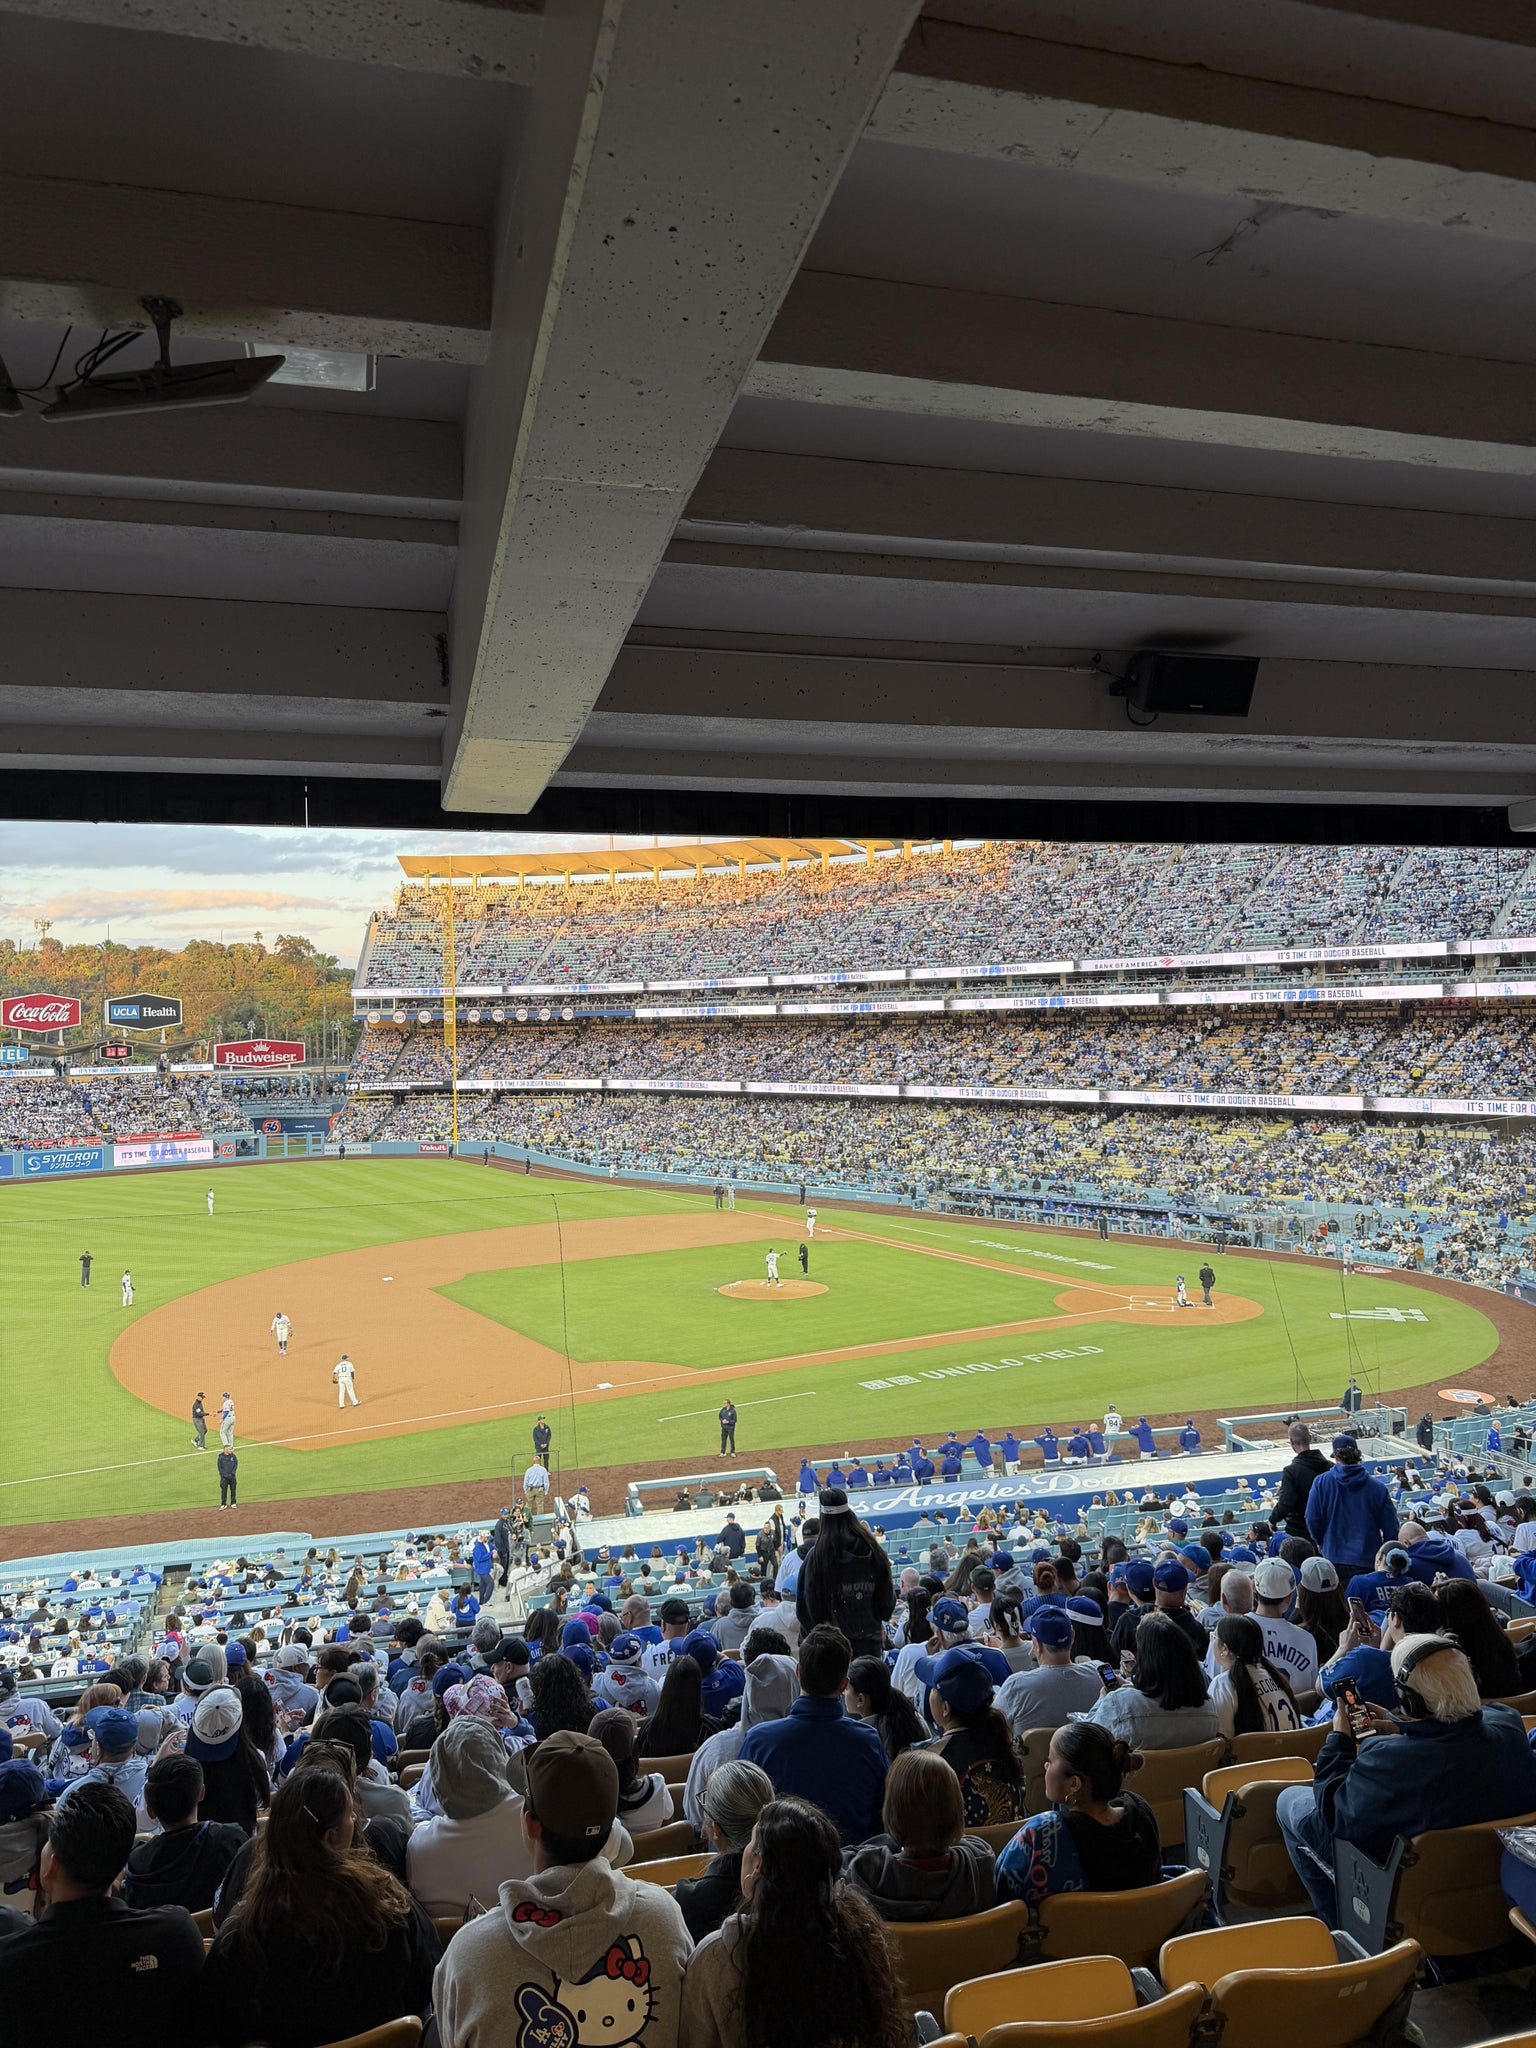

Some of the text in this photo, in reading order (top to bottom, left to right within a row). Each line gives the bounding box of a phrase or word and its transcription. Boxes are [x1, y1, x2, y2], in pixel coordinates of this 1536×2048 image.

[1278, 948, 1386, 960] IT'S TIME FOR DODGER BASEBALL
[1251, 992, 1264, 1000] IT'S
[1265, 991, 1282, 1000] TIME
[1283, 991, 1297, 999] FOR
[1328, 989, 1364, 998] BASEBALL
[1071, 997, 1098, 1005] BASEBALL
[9, 1002, 73, 1022] Coca-Cola
[113, 1008, 138, 1016] UCLA
[143, 1007, 177, 1017] Health
[224, 1052, 297, 1064] Budweiser
[971, 1089, 983, 1097] TIME
[985, 1089, 995, 1097] FOR
[1020, 1090, 1049, 1099] BASEBALL
[1178, 1094, 1296, 1107] IT'S TIME FOR DODGER BASEBALL
[1467, 1102, 1484, 1112] IT'S
[1487, 1103, 1508, 1113] TIME
[1510, 1103, 1527, 1113] FOR
[266, 1122, 277, 1132] 76
[183, 1146, 211, 1154] BASEBALL
[223, 1144, 233, 1154] 76
[420, 1143, 447, 1151] Yakult
[42, 1152, 99, 1164] SYNCRON
[918, 1358, 1025, 1380] UNIQLO
[1022, 1345, 1105, 1363] FIELD
[873, 1483, 1034, 1511] Angeles
[1376, 1586, 1400, 1601] BET
[1263, 1641, 1311, 1672] AMOTO
[57, 1670, 67, 1678] 17
